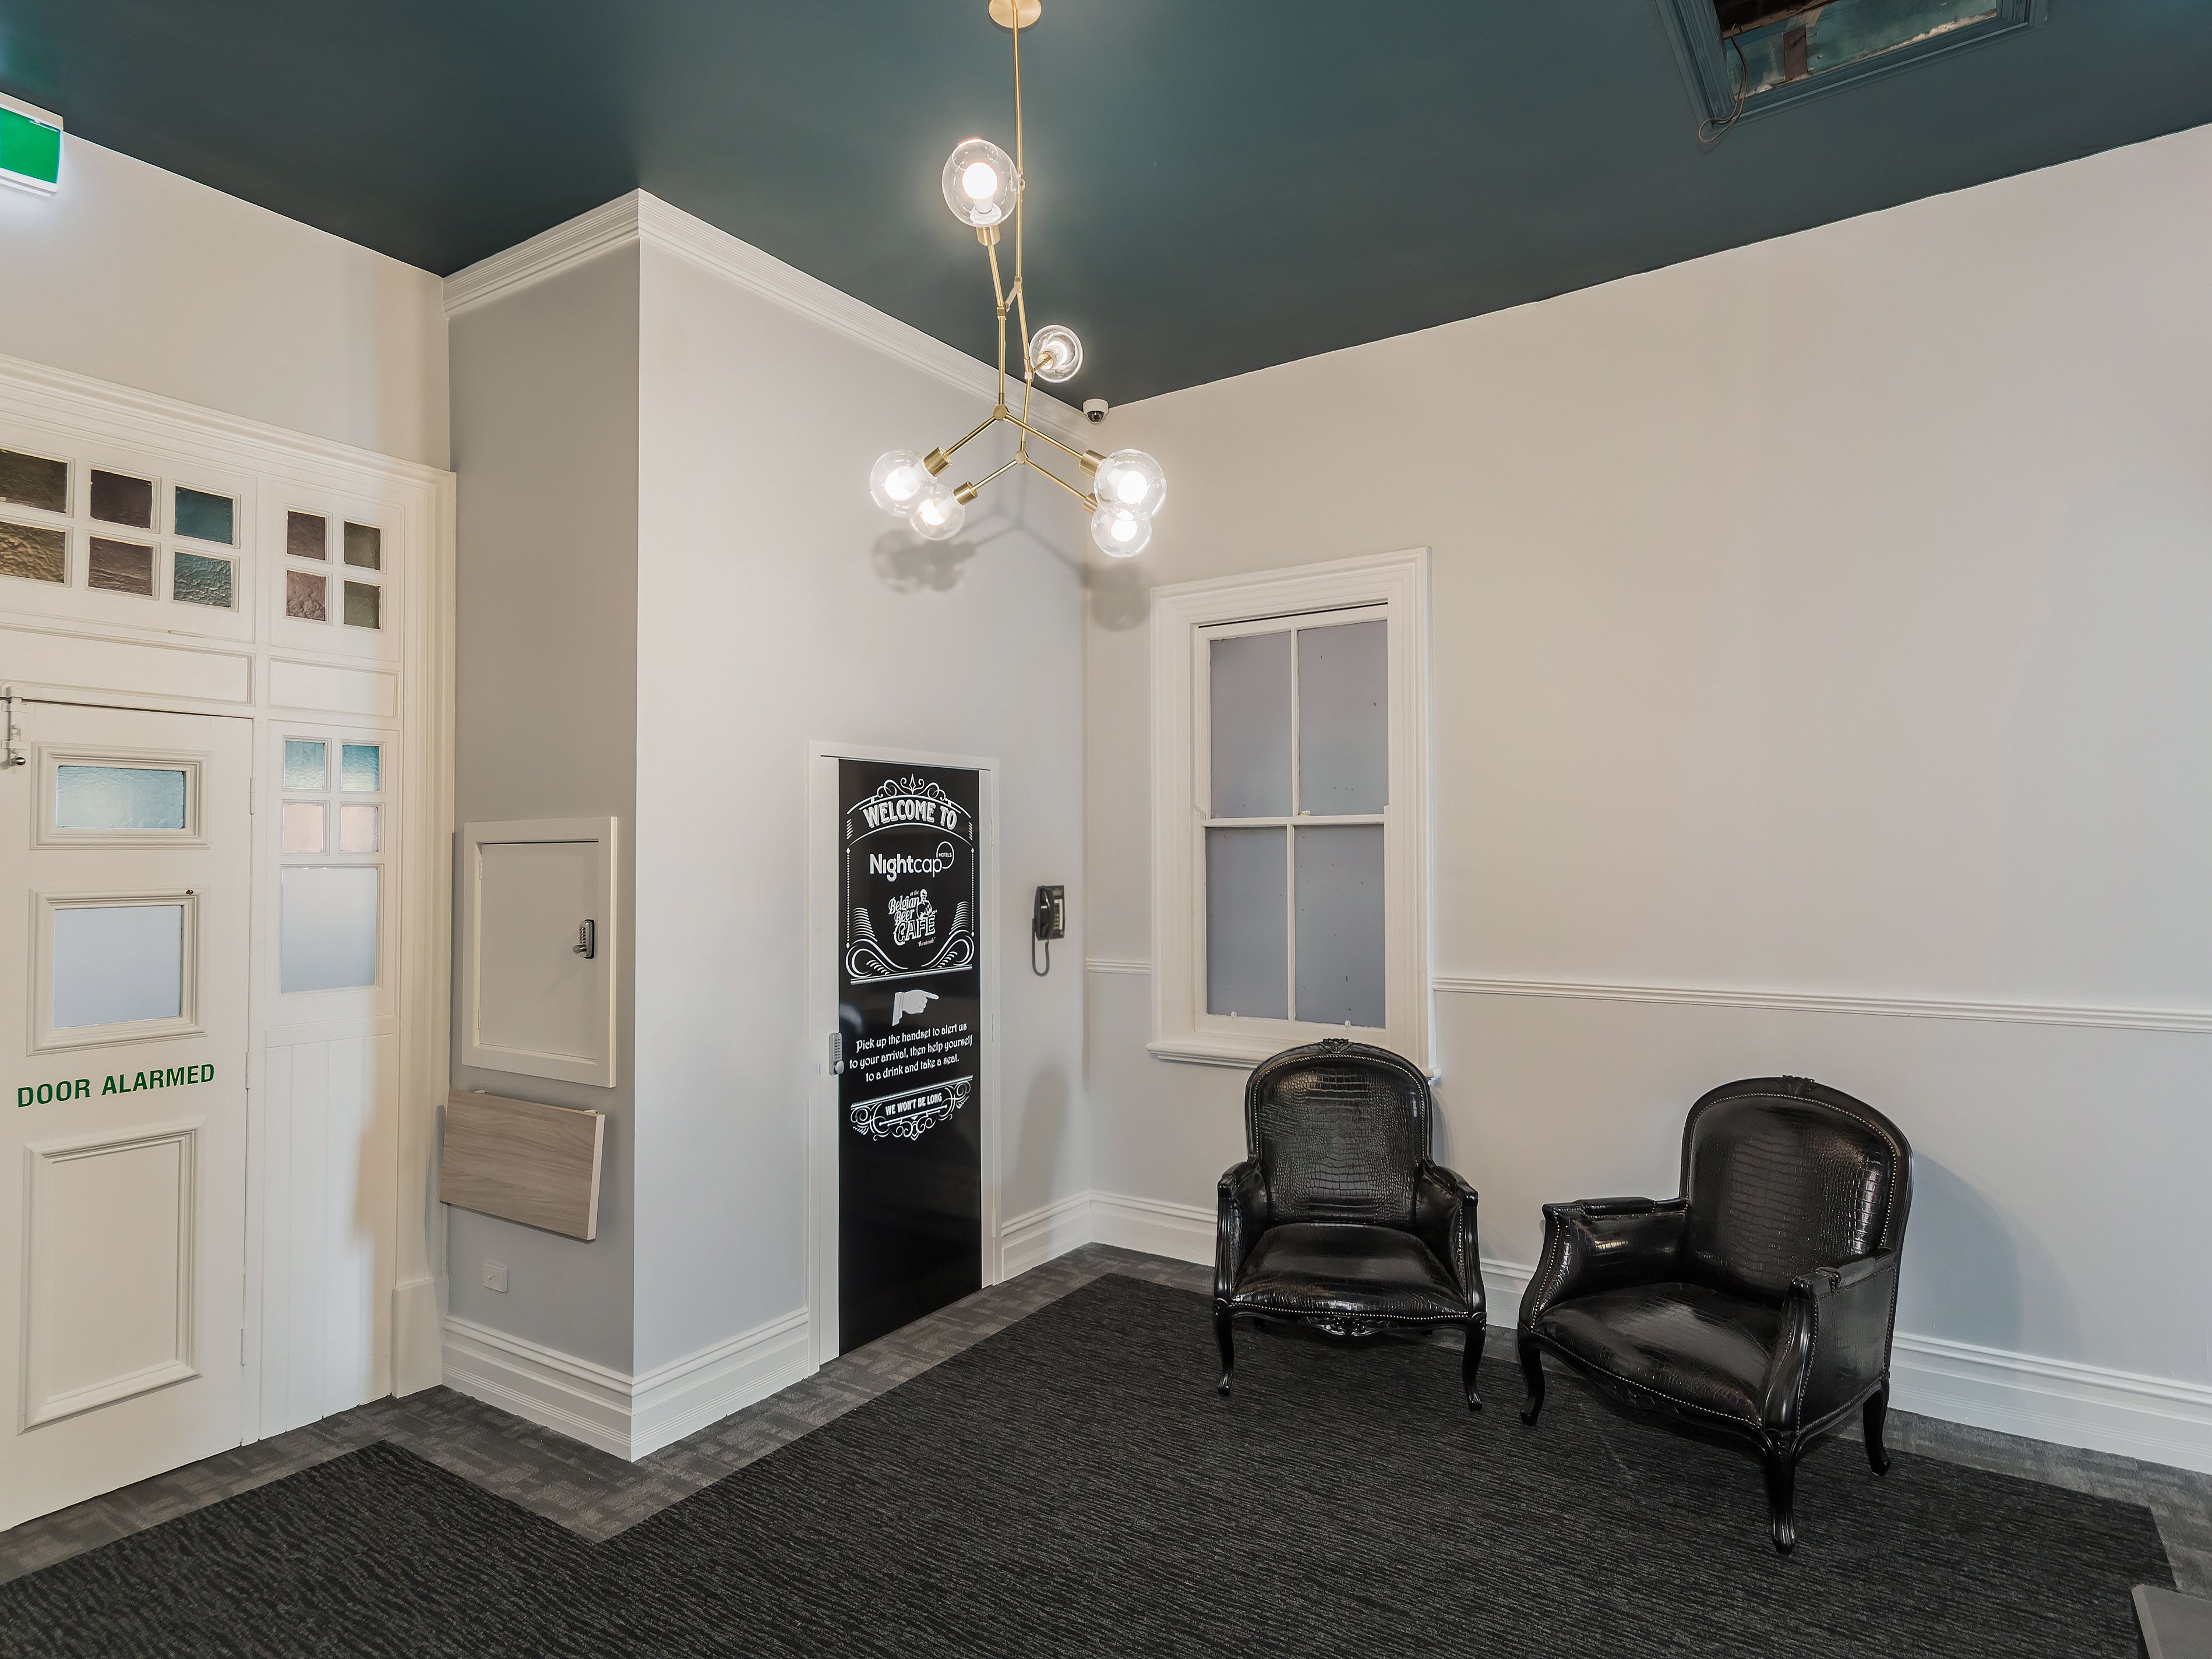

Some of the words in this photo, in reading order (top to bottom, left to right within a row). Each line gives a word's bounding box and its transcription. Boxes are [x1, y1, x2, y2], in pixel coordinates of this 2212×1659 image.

[862, 799, 936, 828] WELCOME
[940, 806, 957, 830] TO
[870, 853, 943, 882] Nightcap
[888, 895, 919, 915] Belgian
[894, 909, 915, 926] Beer
[849, 1059, 858, 1069] to
[860, 1056, 880, 1069] your
[881, 1047, 909, 1063] arrival,
[910, 1046, 926, 1057] then
[927, 1041, 943, 1053] help
[944, 1034, 973, 1052] yourself
[856, 1038, 874, 1053] Pick
[876, 1038, 887, 1049] up
[888, 1034, 900, 1045] the
[902, 1028, 931, 1042] handset
[932, 1028, 940, 1036] to
[941, 1023, 957, 1035] alert
[958, 1023, 967, 1032] us
[866, 1072, 874, 1082] to
[876, 1072, 881, 1080] a
[883, 1064, 904, 1078] drink
[904, 1061, 919, 1074] and
[920, 1058, 936, 1070] take
[937, 1058, 941, 1067] a
[943, 1053, 959, 1065] seat.
[17, 1078, 91, 1108] DOOR
[101, 1063, 215, 1096] ALARMED
[885, 1104, 896, 1116] WE
[897, 1099, 917, 1113] WON'T
[918, 1096, 926, 1108] BE
[927, 1092, 943, 1105] LONG
